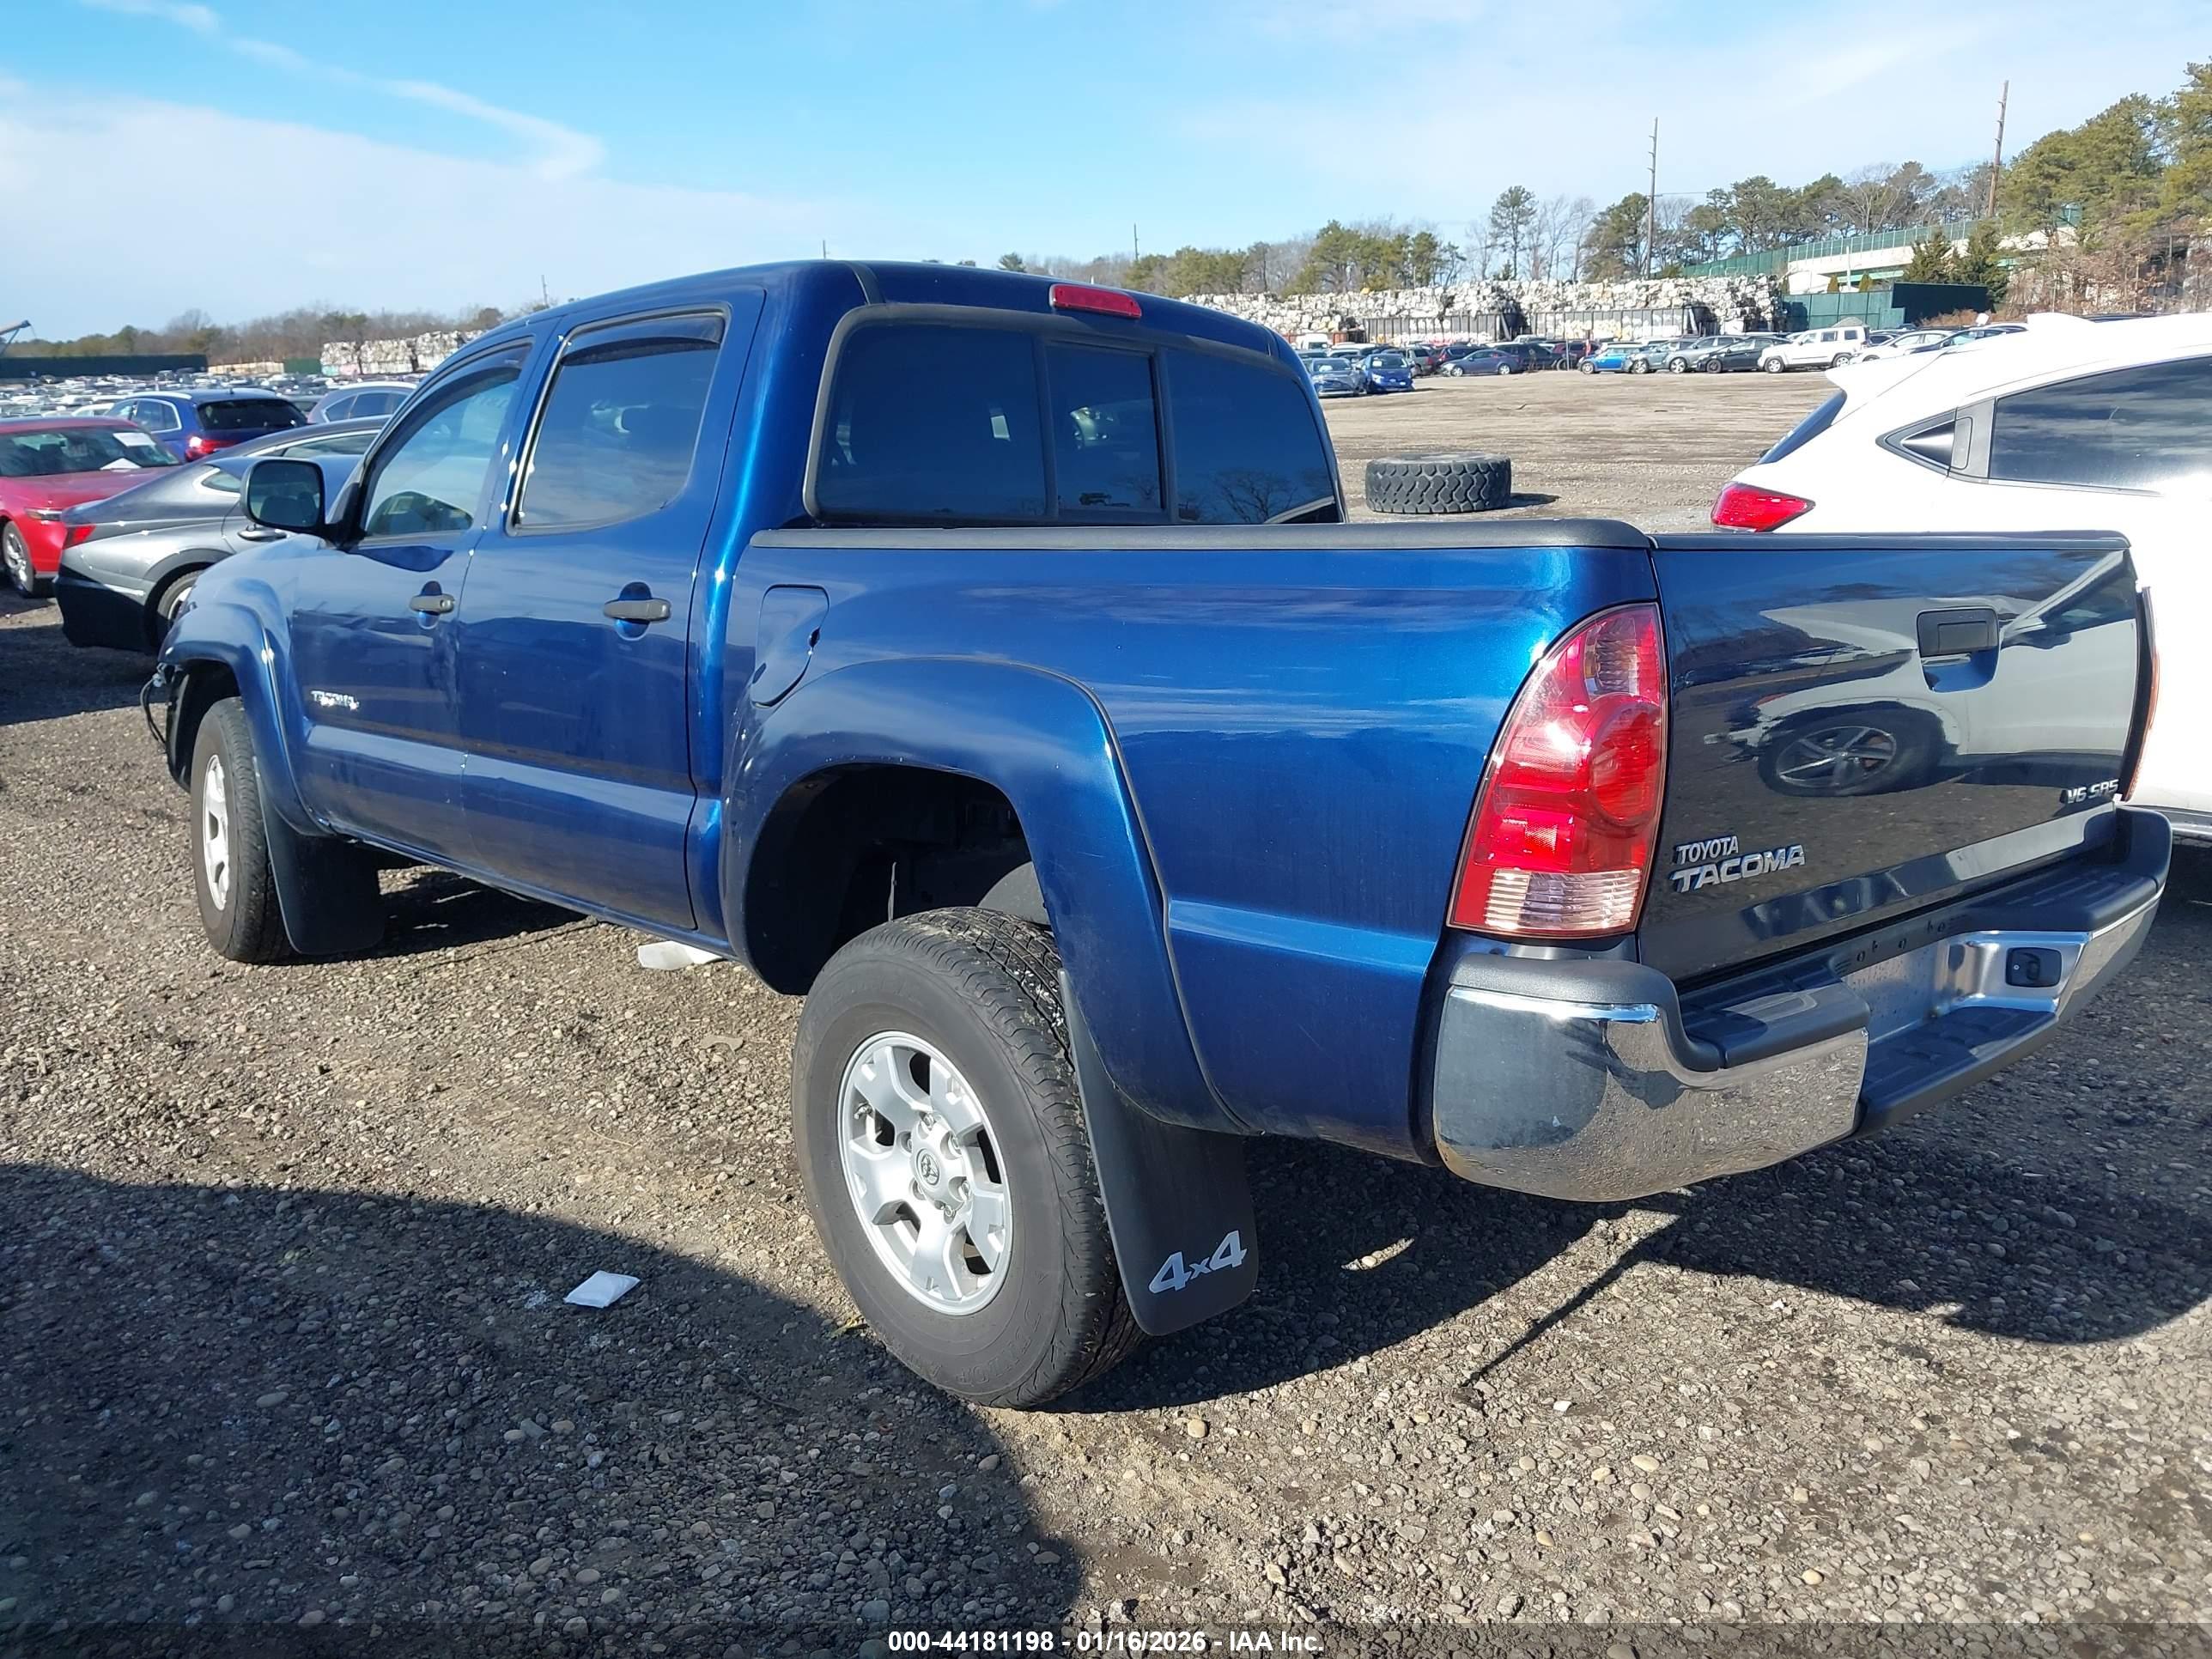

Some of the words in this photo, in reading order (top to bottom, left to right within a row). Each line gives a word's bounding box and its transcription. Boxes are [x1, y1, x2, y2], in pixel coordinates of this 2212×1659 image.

[2067, 787, 2087, 804] V6
[2087, 779, 2120, 799] SR5
[1670, 844, 1806, 893] TACOMA
[1675, 835, 1740, 866] TOYOTA
[1148, 1229, 1248, 1294] 4x4
